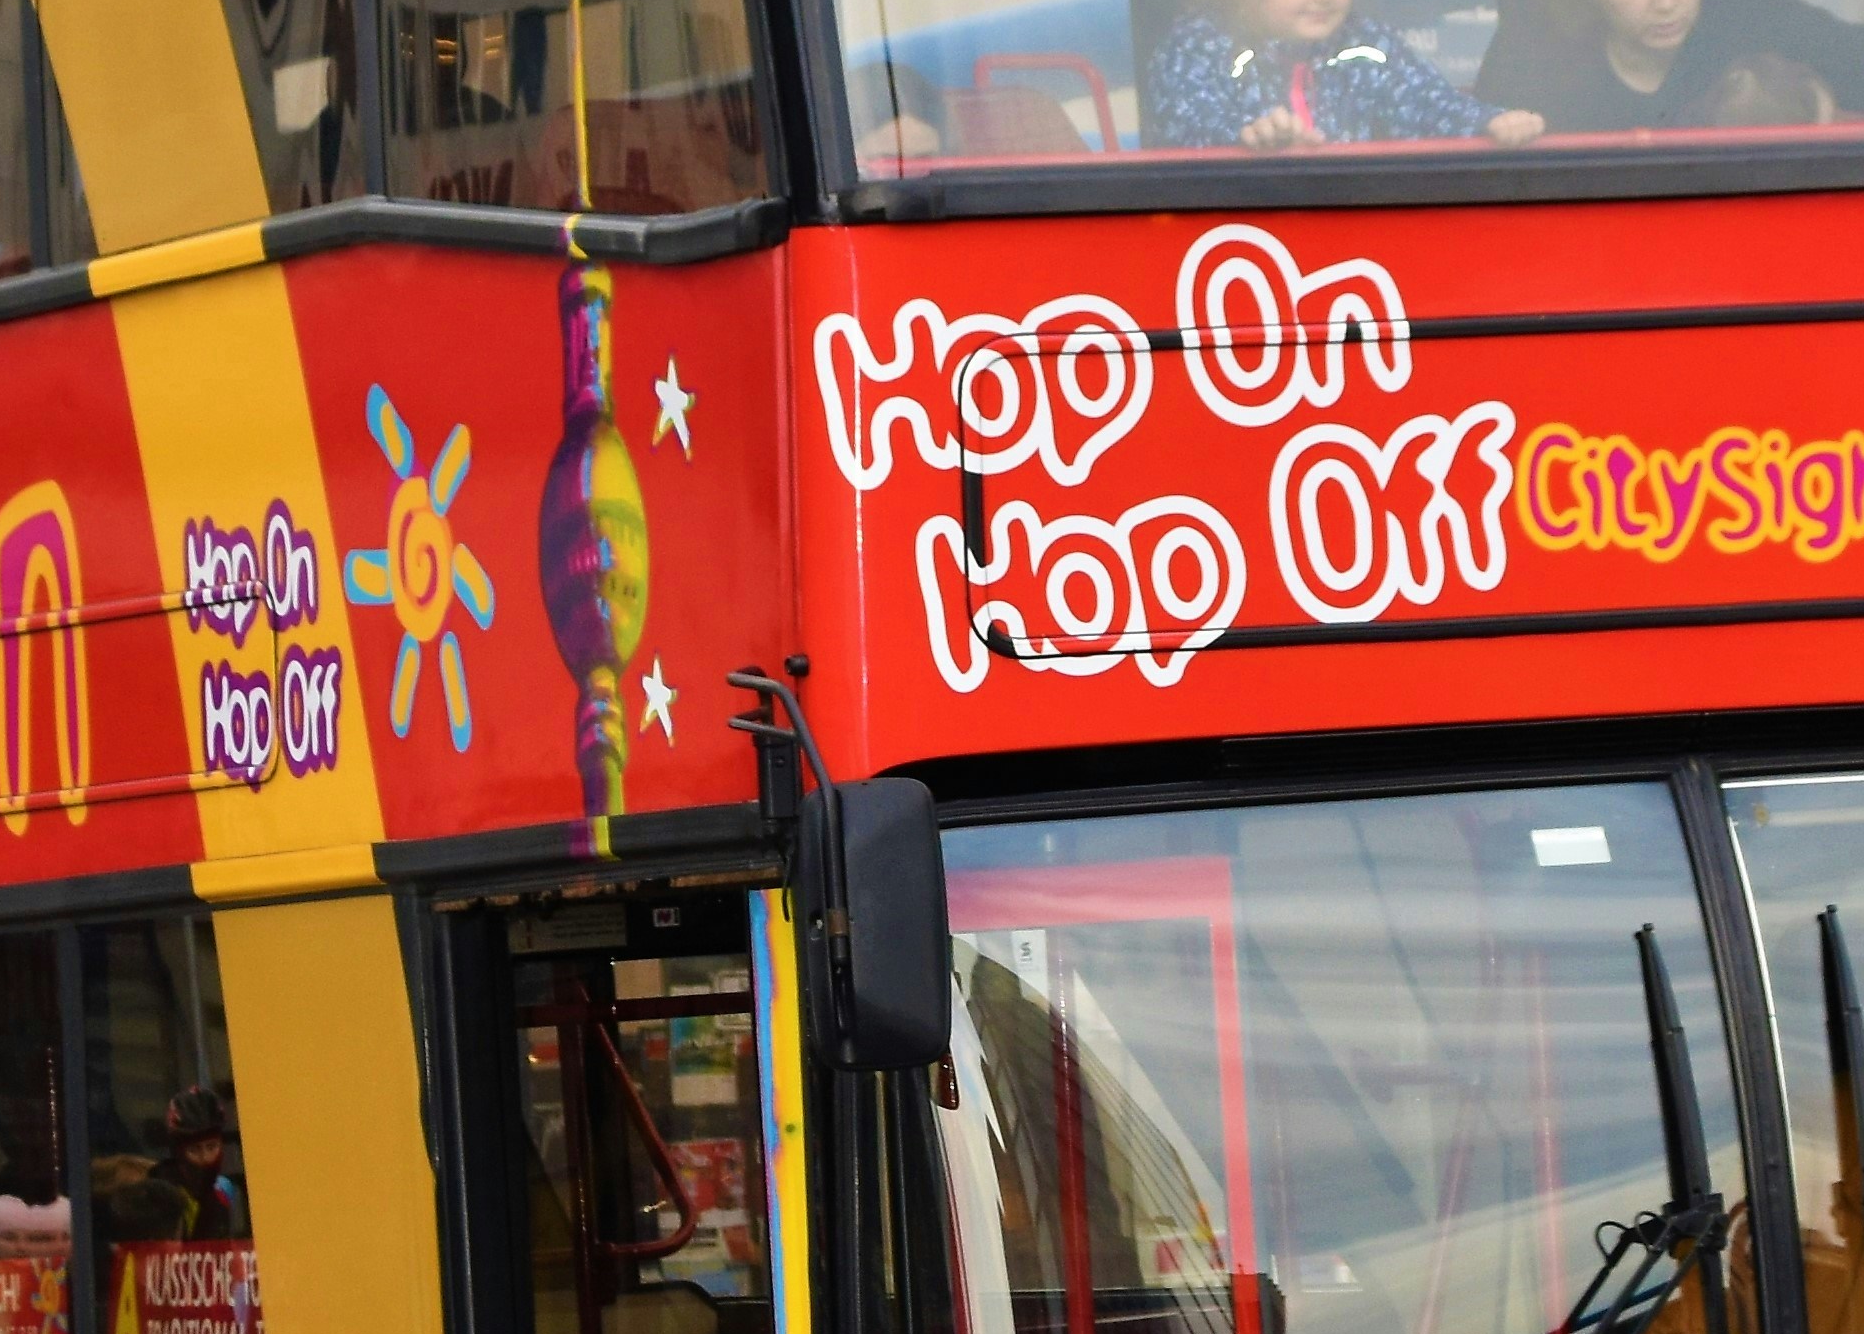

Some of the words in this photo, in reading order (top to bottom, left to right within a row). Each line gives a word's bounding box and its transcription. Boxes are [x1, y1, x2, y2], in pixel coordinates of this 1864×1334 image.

[814, 294, 1153, 491] Hop
[1176, 224, 1412, 427] On
[186, 527, 257, 637] Hop
[266, 509, 317, 622] On
[915, 495, 1246, 693] Hop
[1269, 401, 1517, 624] Off
[204, 670, 275, 782] Hop
[283, 654, 339, 769] Off
[145, 1251, 235, 1308] KLASSISCHE
